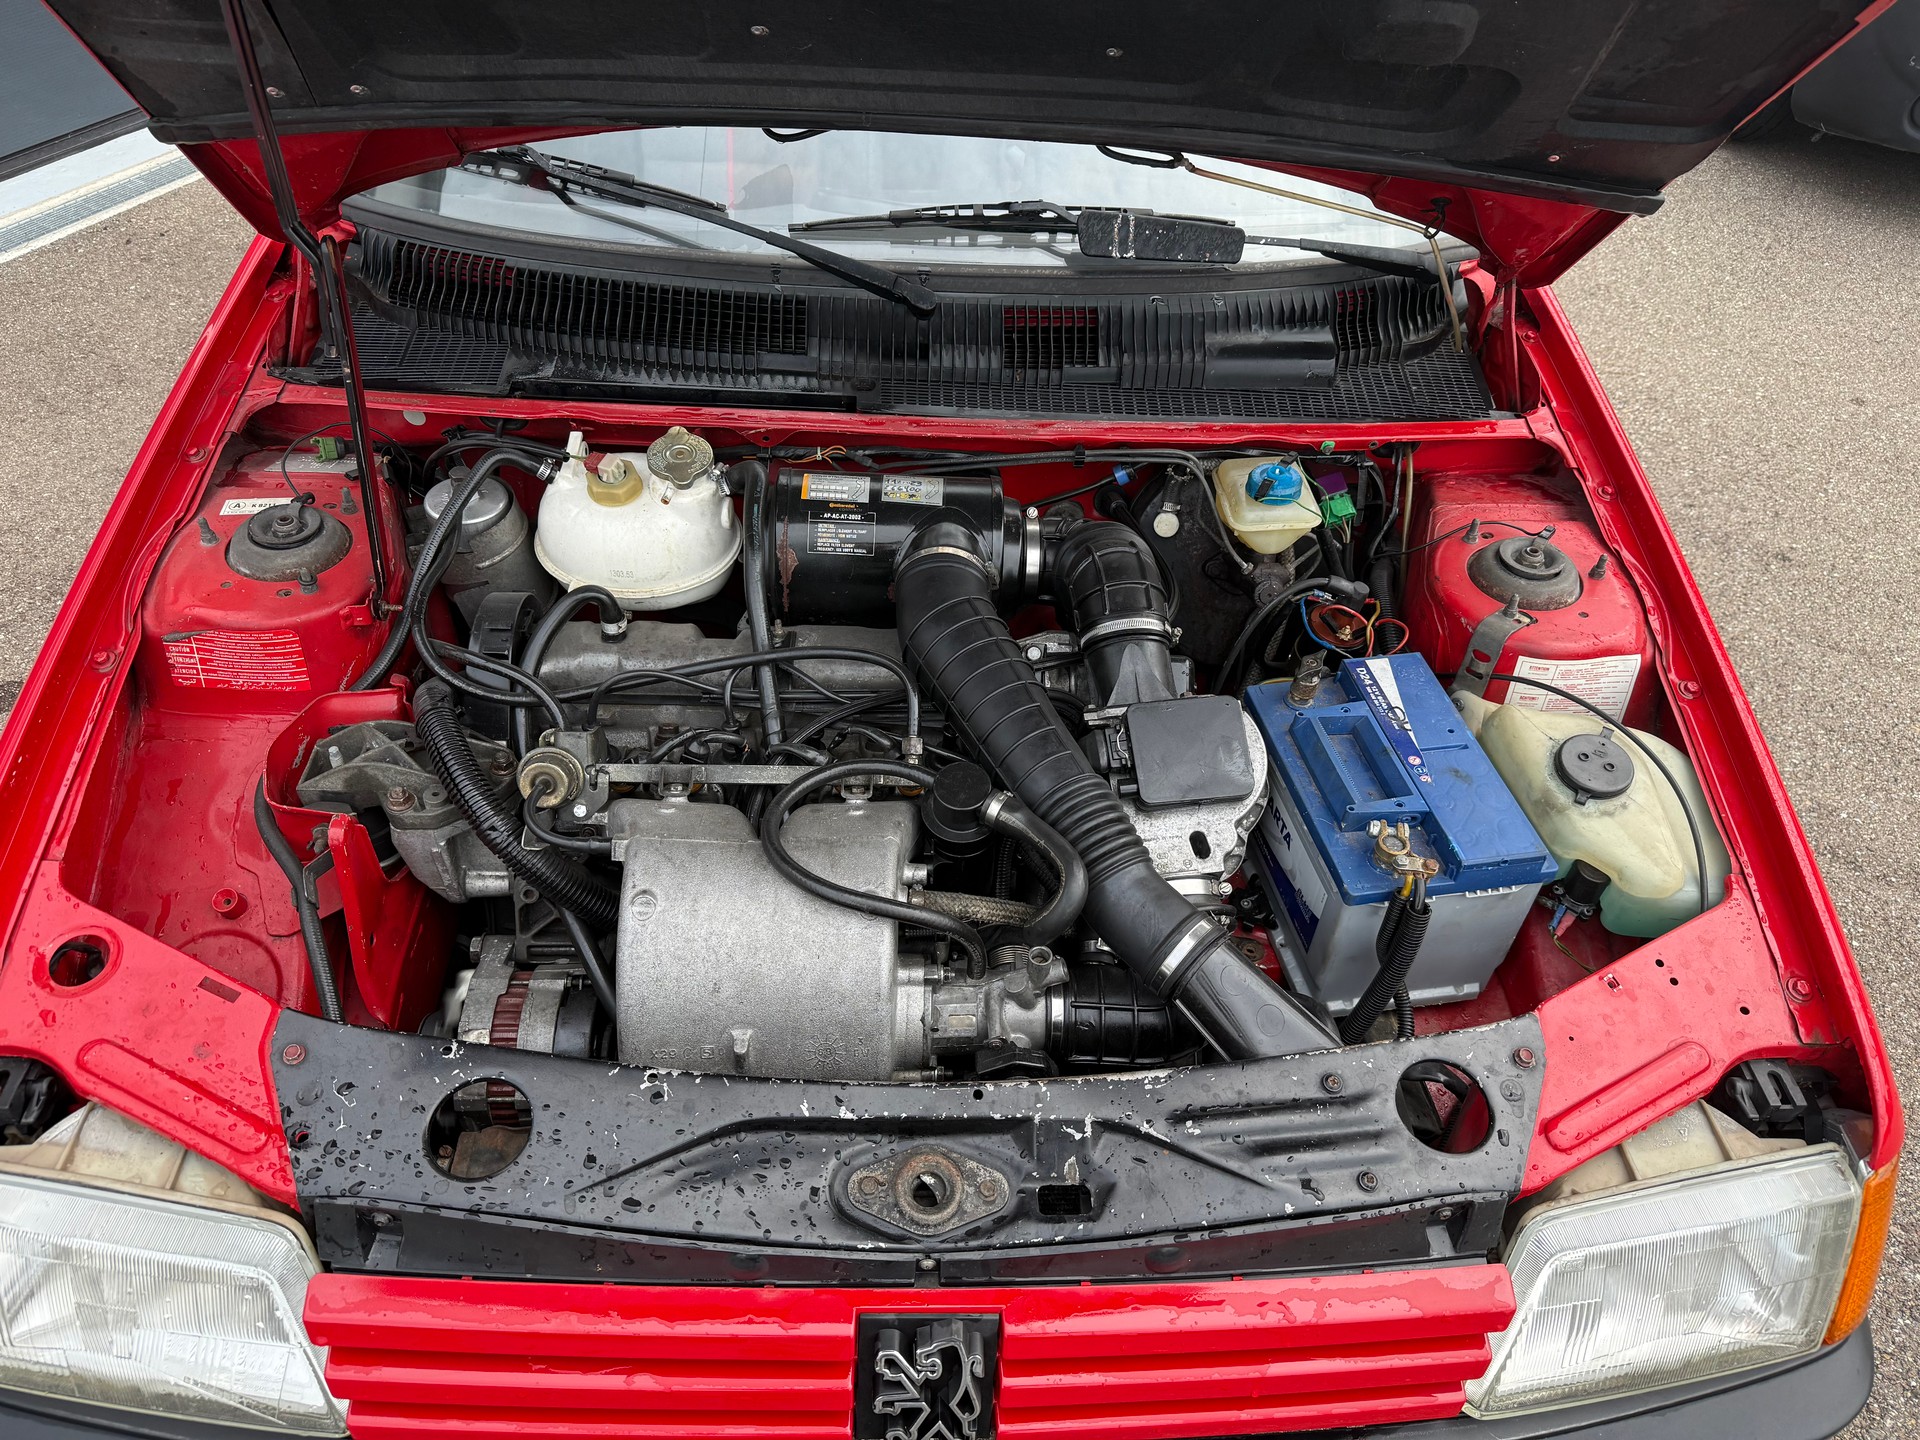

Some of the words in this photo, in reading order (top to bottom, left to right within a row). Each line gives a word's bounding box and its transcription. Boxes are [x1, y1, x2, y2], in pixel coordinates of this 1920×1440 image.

[168, 645, 191, 653] CAUTION
[1355, 667, 1374, 685] D24
[1267, 796, 1292, 853] ARTA
